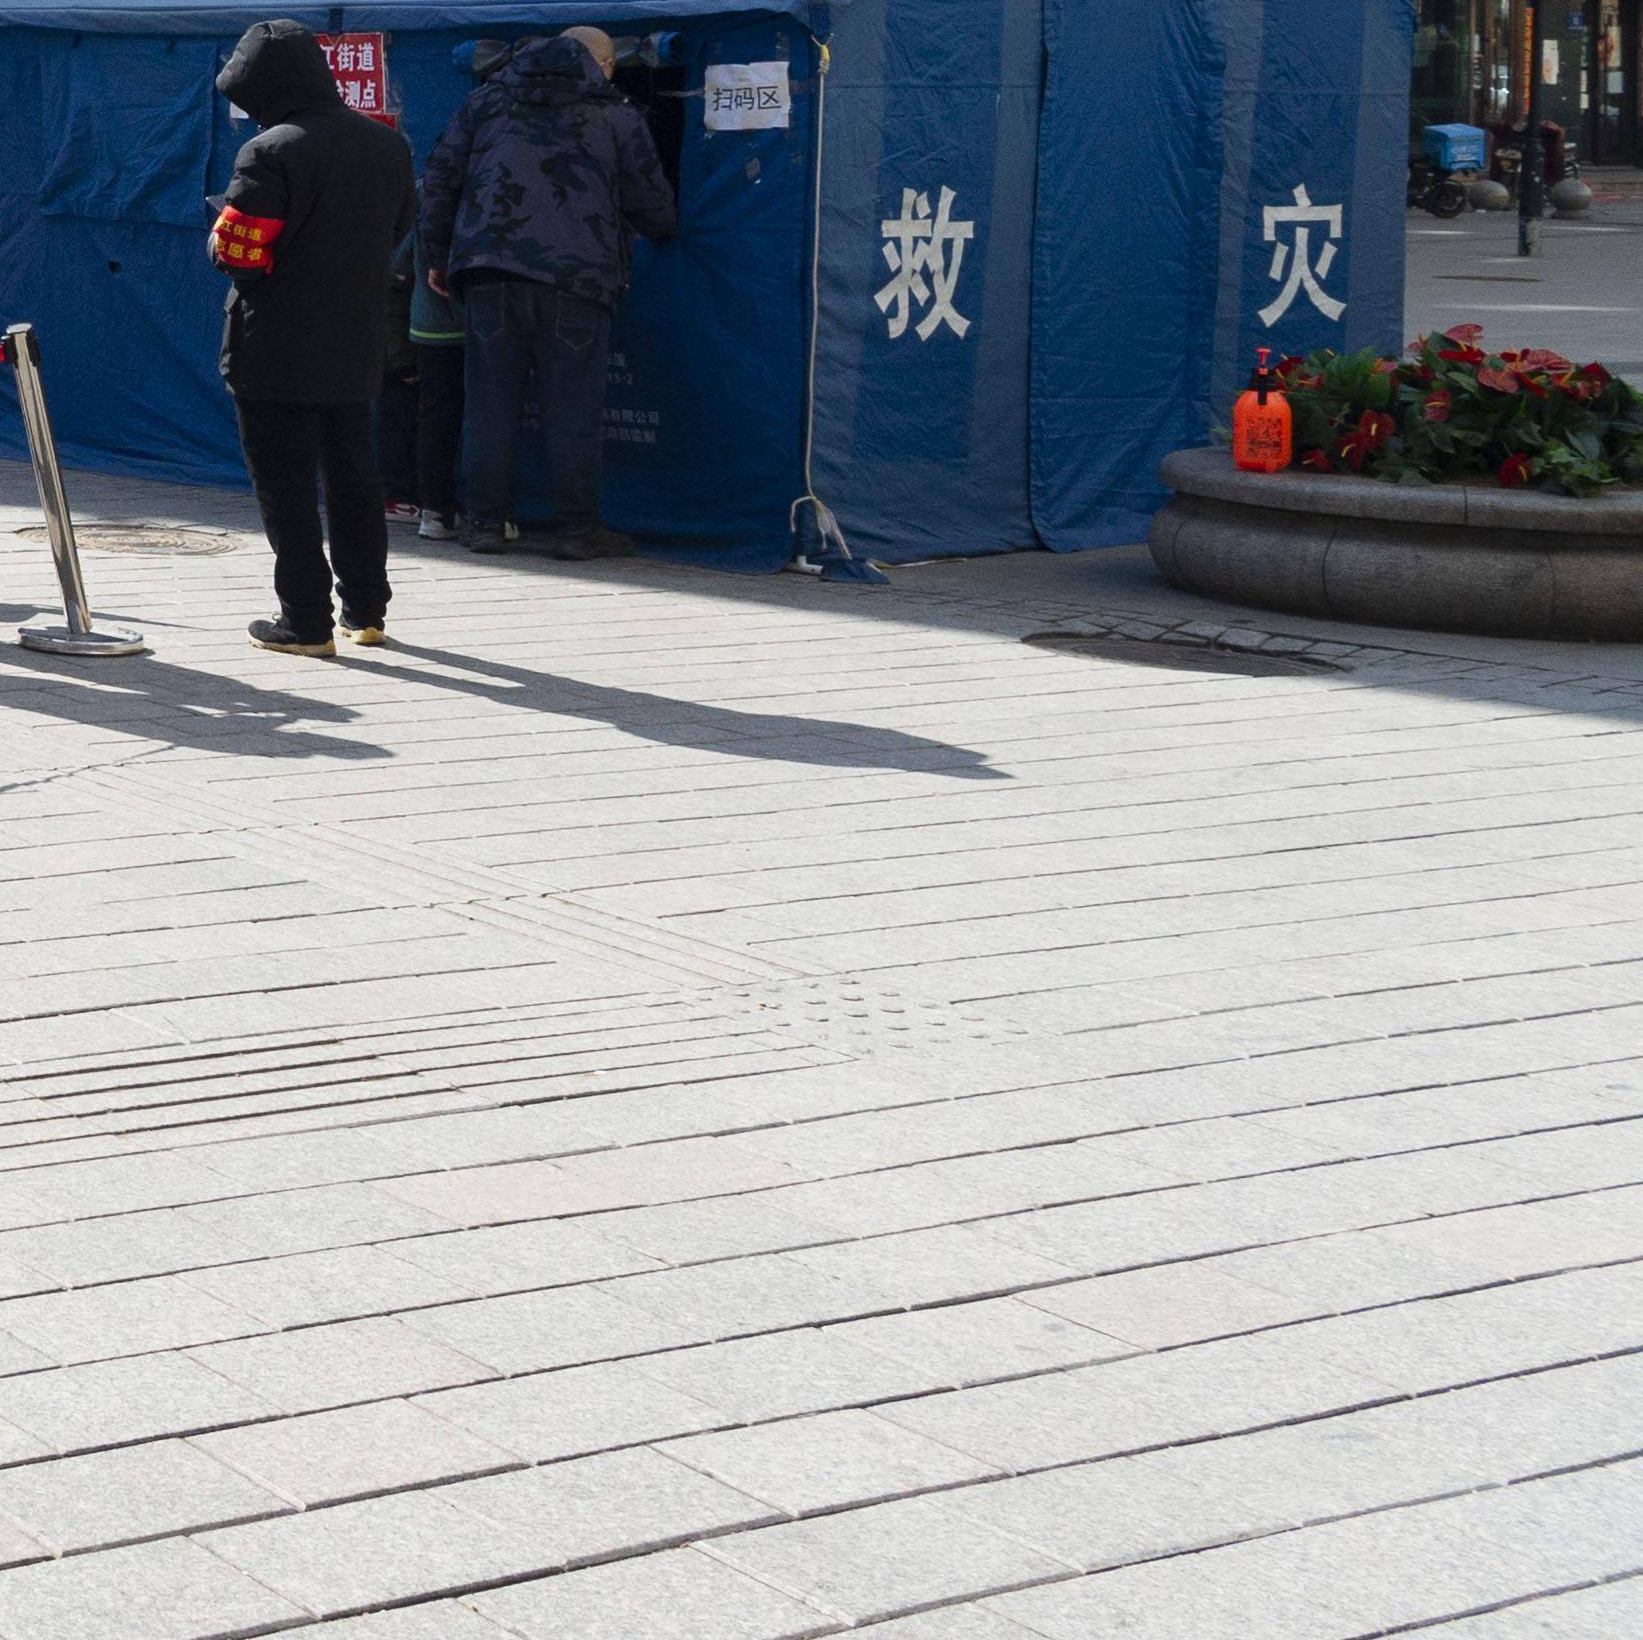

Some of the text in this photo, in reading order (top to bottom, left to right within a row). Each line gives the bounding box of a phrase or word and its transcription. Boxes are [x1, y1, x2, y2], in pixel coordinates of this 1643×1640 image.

[712, 86, 782, 111] 扫码区
[874, 182, 1346, 342] 救 灾
